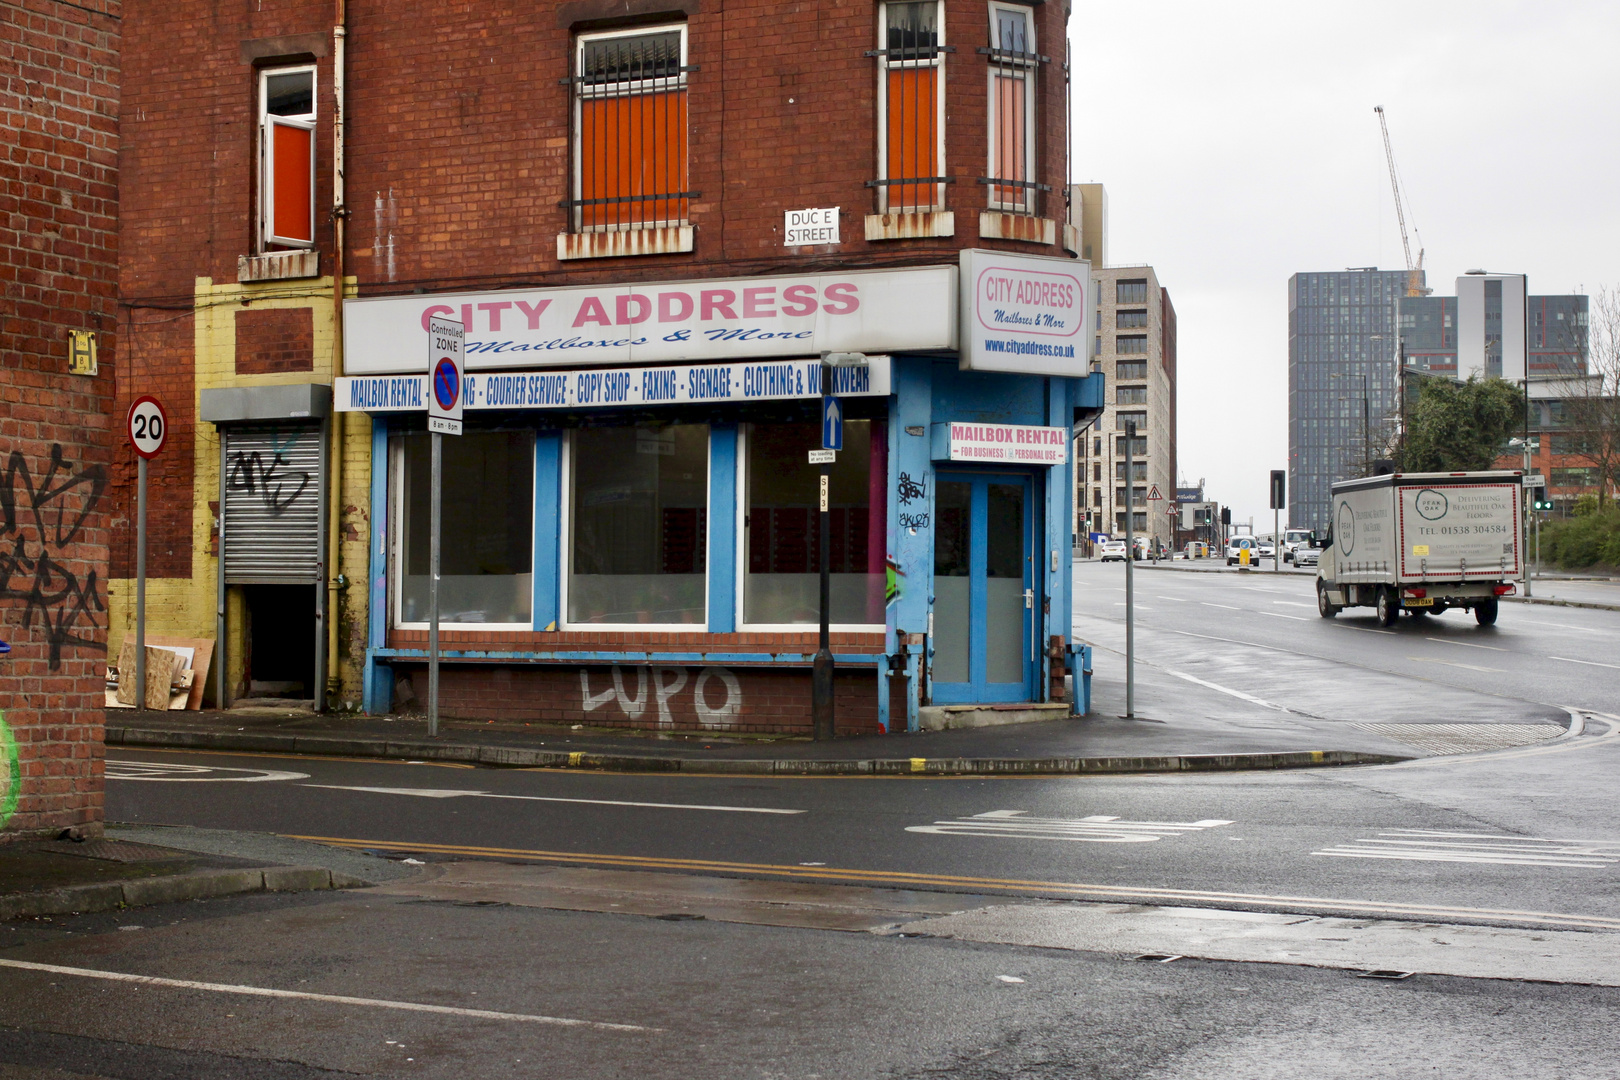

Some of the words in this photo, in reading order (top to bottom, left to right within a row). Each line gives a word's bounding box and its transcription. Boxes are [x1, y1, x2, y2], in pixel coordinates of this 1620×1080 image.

[788, 227, 834, 242] STREET
[986, 276, 1013, 303] CITY
[1016, 279, 1073, 309] ADDRESS
[421, 299, 553, 334] CITY
[571, 283, 860, 328] ADDRESS
[994, 309, 1033, 326] Mailboxes
[1035, 313, 1041, 326] &
[1043, 314, 1065, 329] More
[431, 323, 463, 339] Controlled
[464, 336, 649, 354] Mailboxes
[663, 329, 693, 342] &
[704, 328, 813, 342] More
[436, 338, 458, 352] ZONE
[985, 339, 1075, 359] www.cityaddress.co.uk
[351, 378, 389, 408] MAILBOX
[391, 377, 422, 407] RENTAL
[487, 376, 526, 406] COURIER
[528, 375, 567, 405] SERVICE
[577, 373, 603, 403] COPY
[605, 371, 630, 402] SHOP
[643, 370, 676, 400] FAXING
[688, 367, 731, 399] SIGNAGE
[744, 364, 793, 397] CLOTHING
[796, 368, 803, 394] &
[807, 363, 870, 394] WOKWEAR
[134, 413, 162, 440] 20
[952, 426, 1013, 443] MAILBOX
[1016, 429, 1065, 445] RENTAL
[961, 447, 973, 457] FOR
[974, 447, 1004, 458] BUSINESS
[1015, 449, 1044, 460] PERSONAL
[1045, 450, 1056, 460] USE
[1441, 526, 1470, 535] 01538
[1473, 525, 1506, 534] 304584
